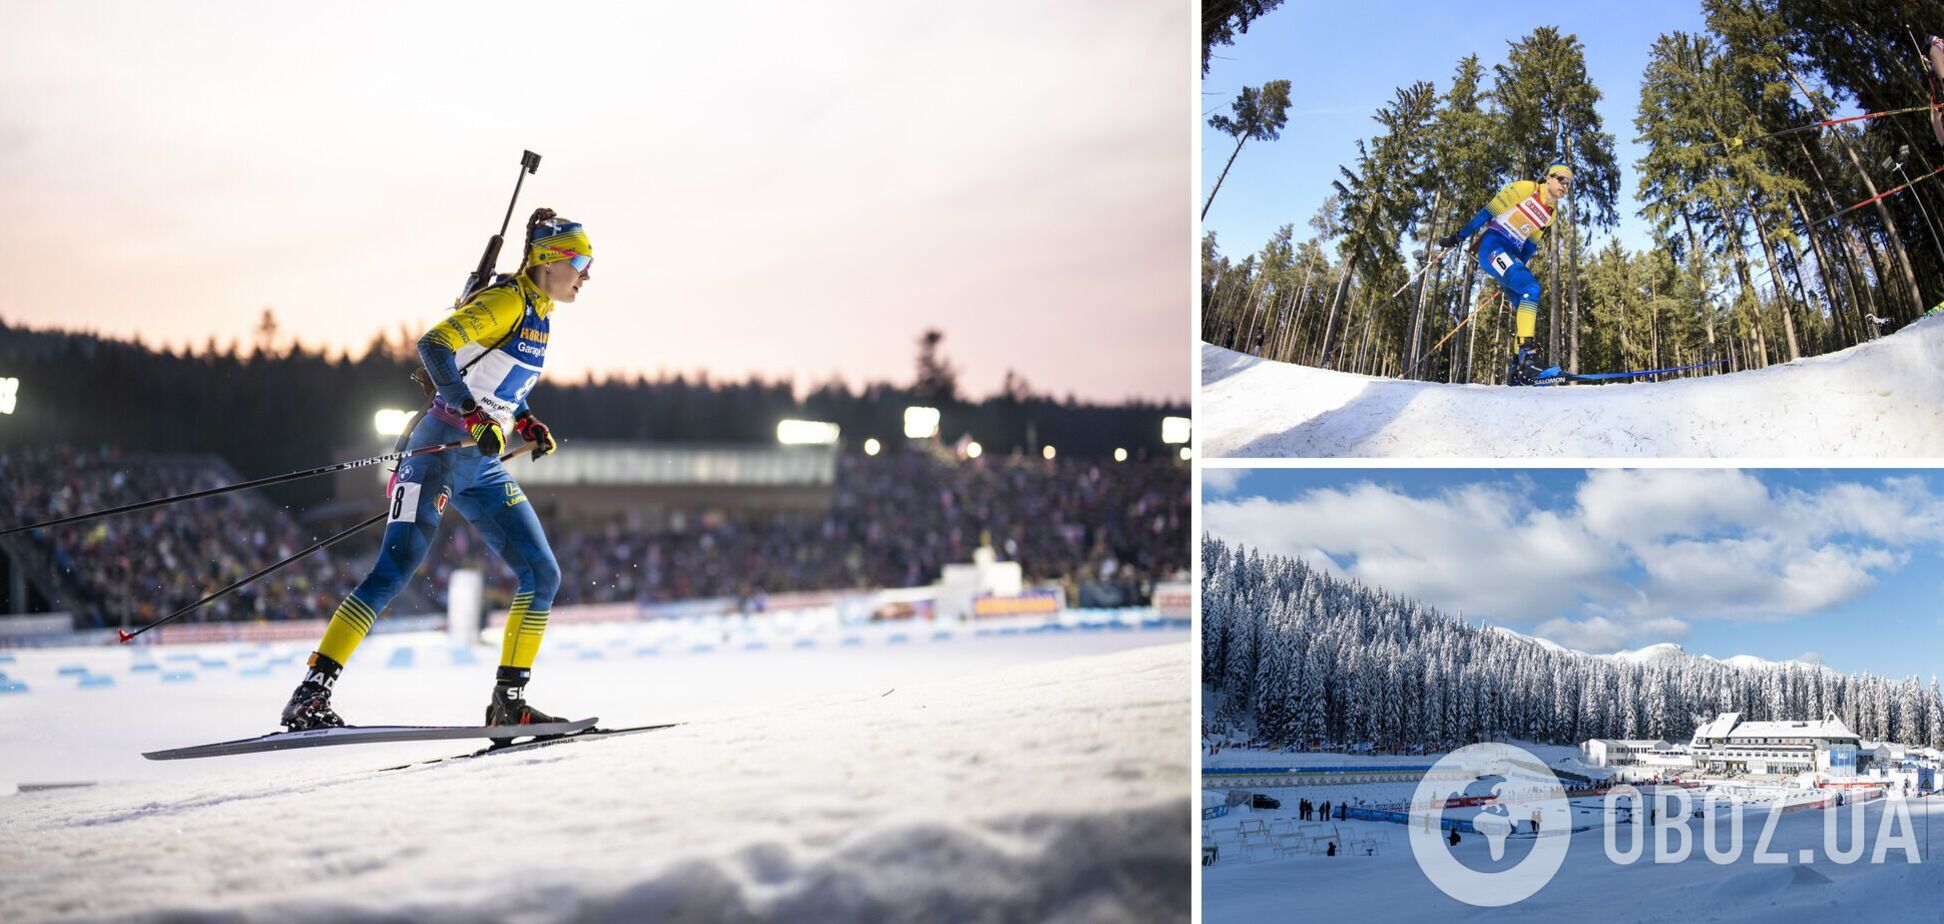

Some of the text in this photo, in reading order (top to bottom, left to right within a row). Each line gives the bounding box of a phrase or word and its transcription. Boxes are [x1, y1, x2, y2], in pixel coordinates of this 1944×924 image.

[1496, 257, 1507, 270] 6
[515, 373, 538, 400] 8
[343, 450, 412, 469] MADSHUS
[392, 486, 405, 519] 8
